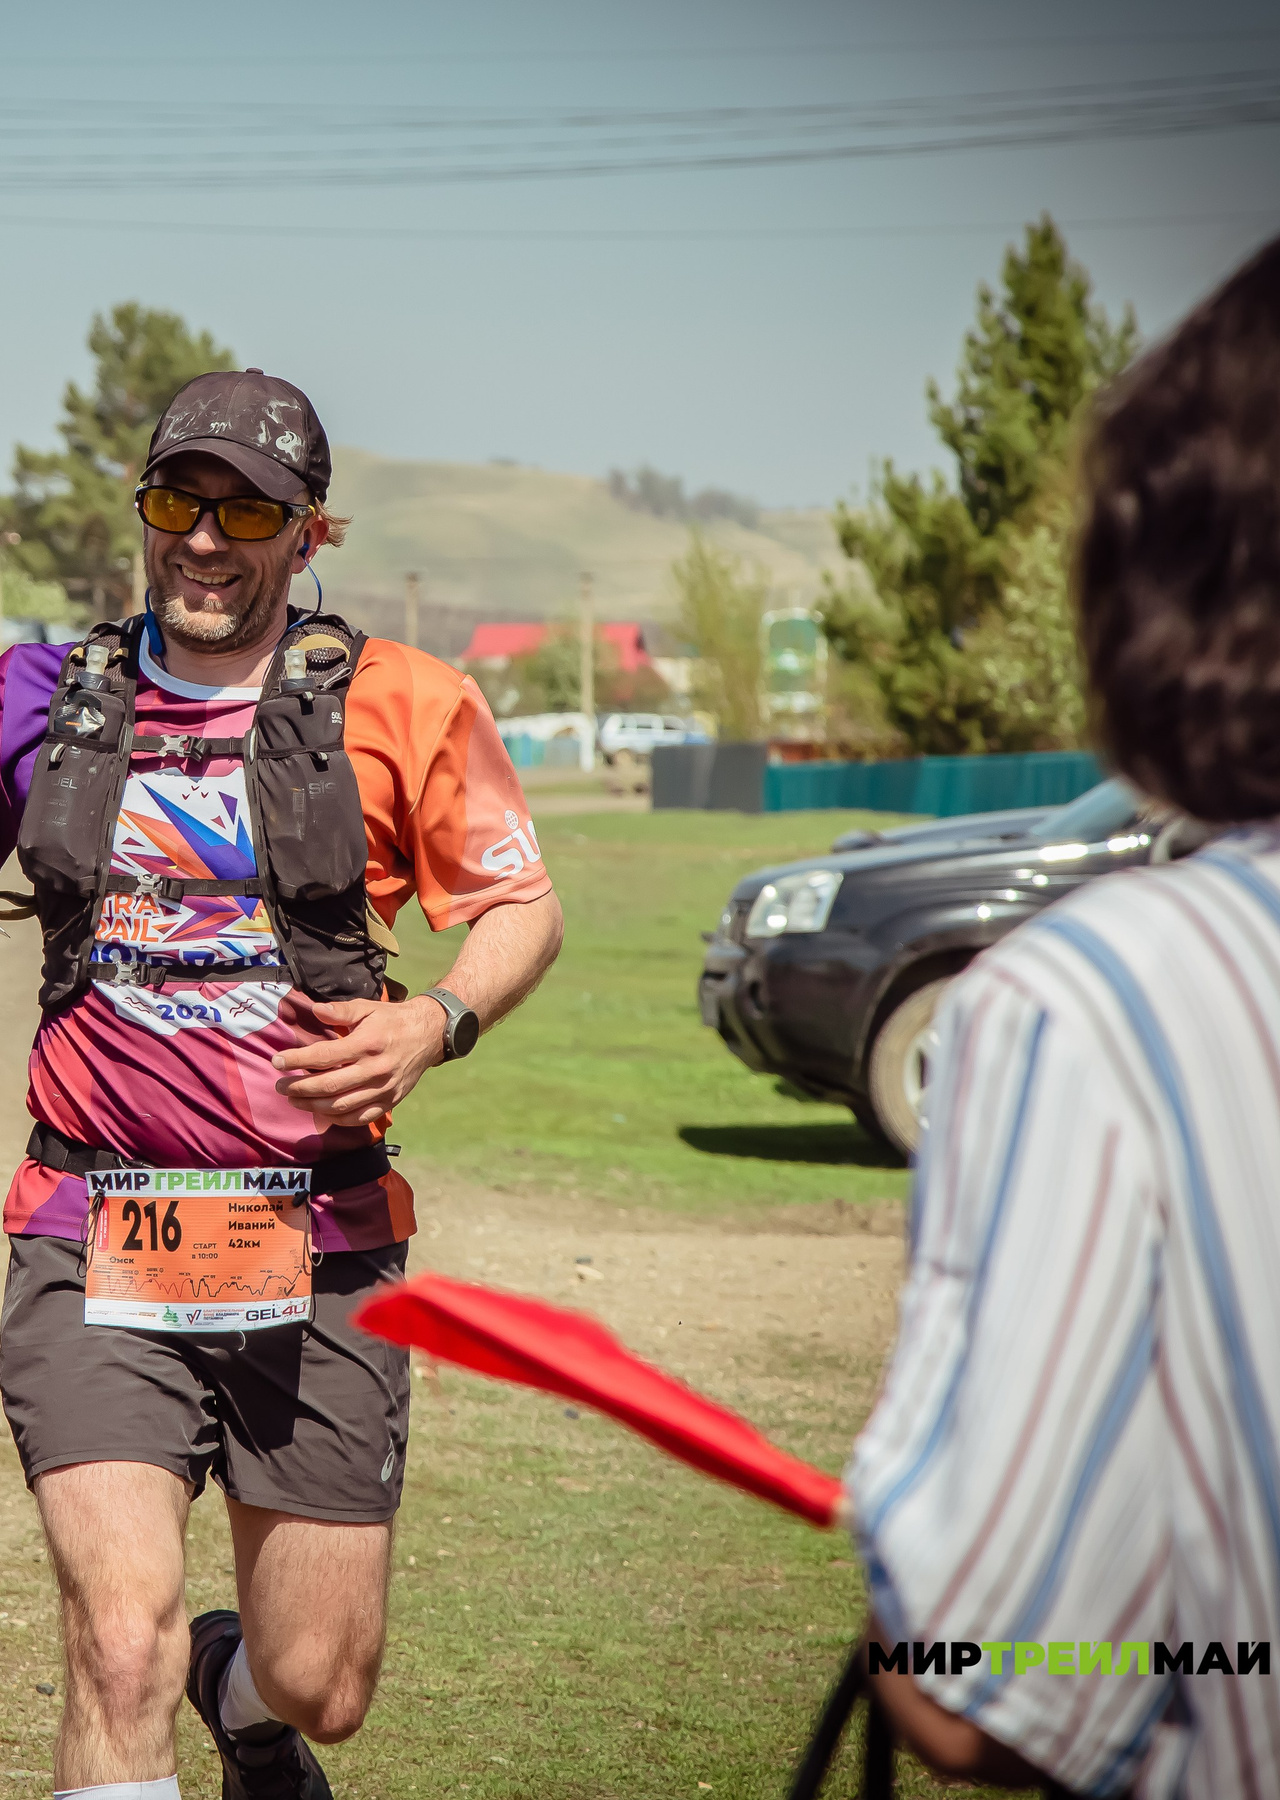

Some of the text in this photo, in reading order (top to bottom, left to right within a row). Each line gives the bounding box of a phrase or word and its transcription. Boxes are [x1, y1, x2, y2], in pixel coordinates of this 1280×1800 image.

[156, 1003, 223, 1023] 2021
[228, 1200, 284, 1212] Николай
[122, 1199, 182, 1252] 216
[228, 1218, 275, 1231] Иваний
[228, 1238, 261, 1249] 42км
[109, 1256, 135, 1264] Омск
[245, 1303, 307, 1322] GEL4U
